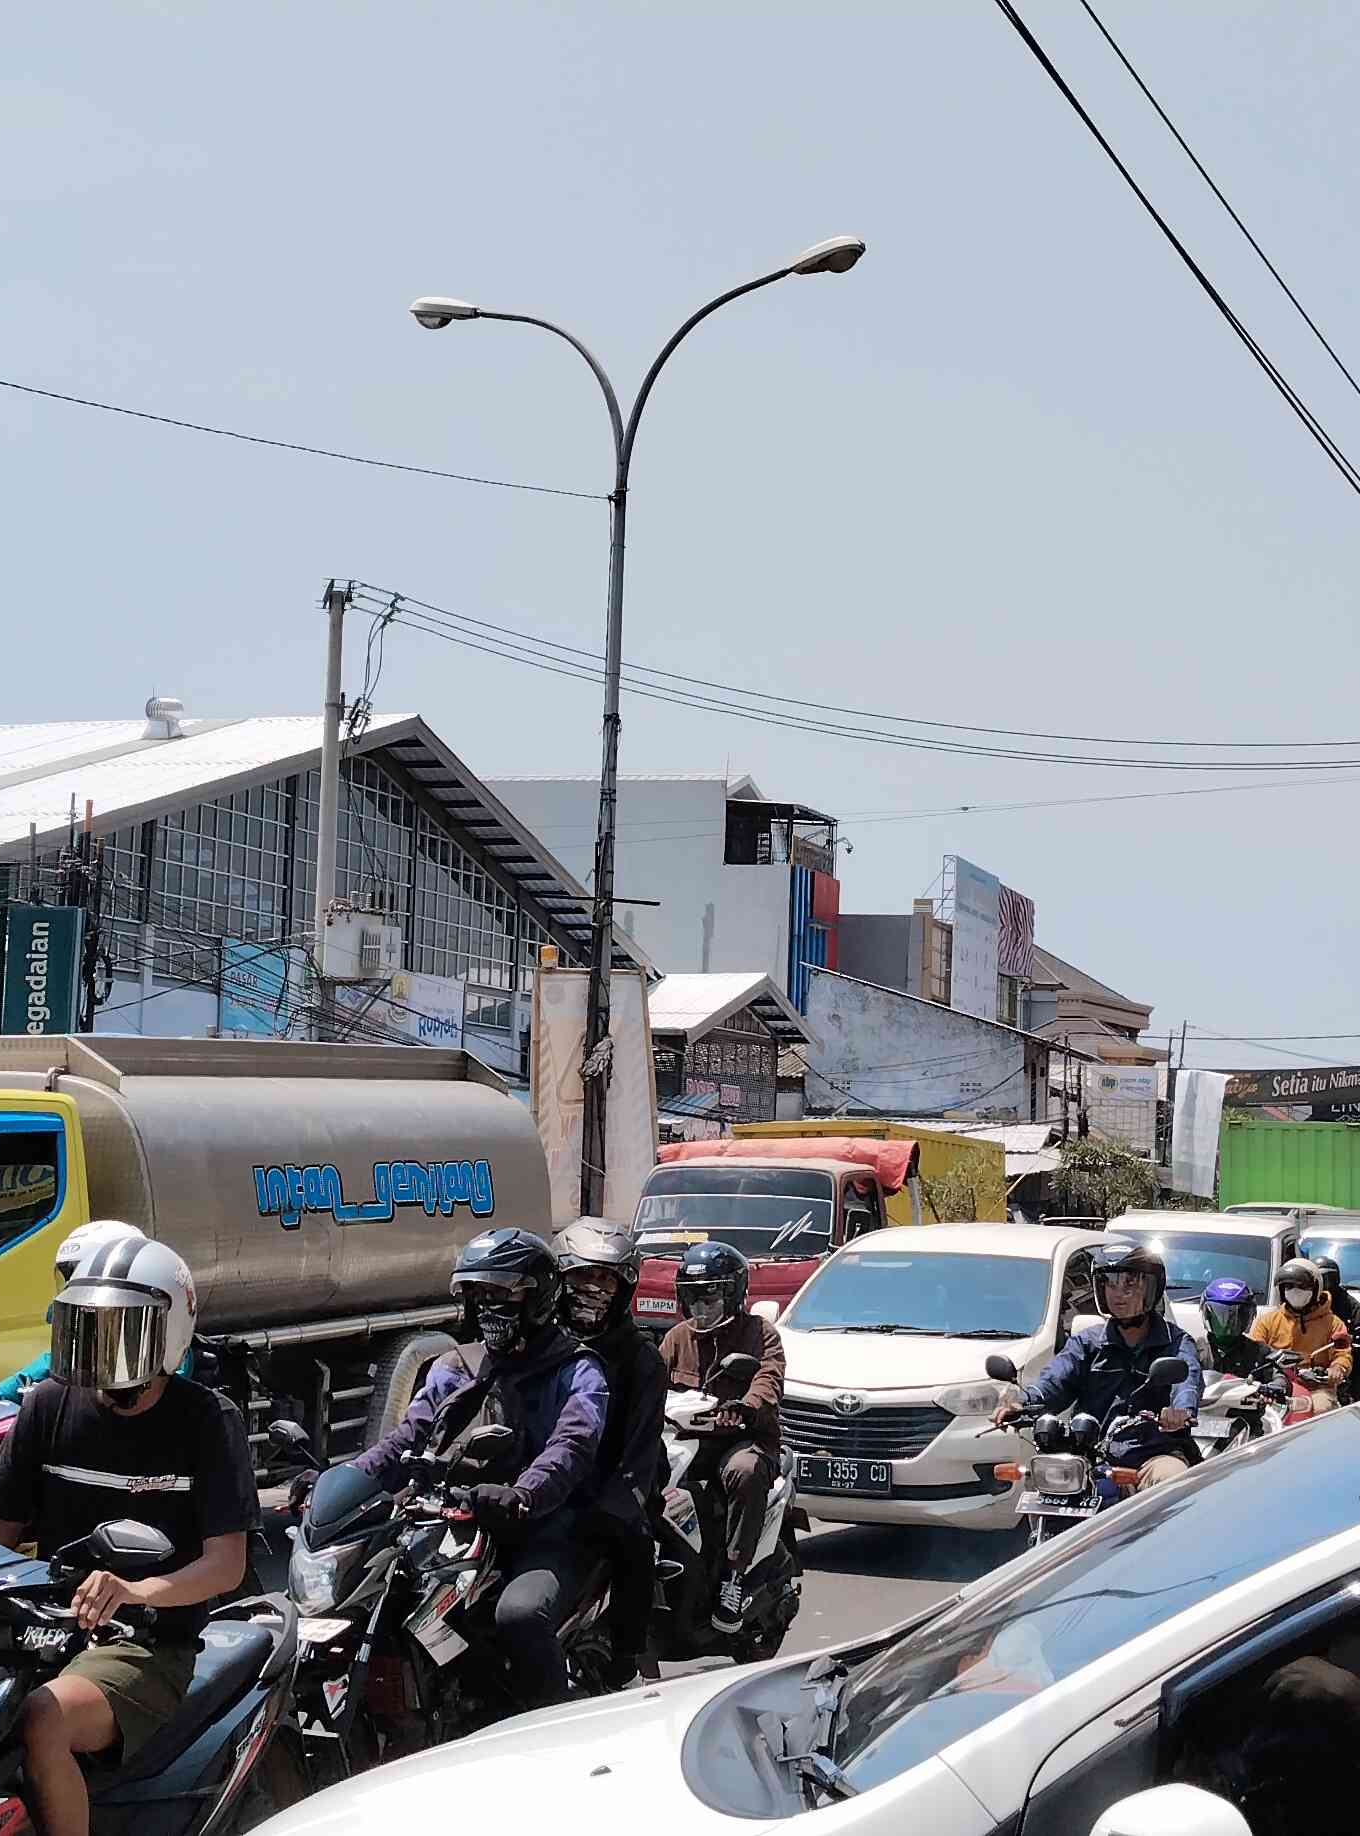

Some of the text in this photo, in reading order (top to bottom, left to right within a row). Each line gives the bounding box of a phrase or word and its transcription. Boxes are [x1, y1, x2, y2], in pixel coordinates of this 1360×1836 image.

[1271, 1072, 1309, 1097] Setia
[1311, 1075, 1327, 1092] itu
[827, 1462, 859, 1480] 1355
[870, 1464, 888, 1482] CD
